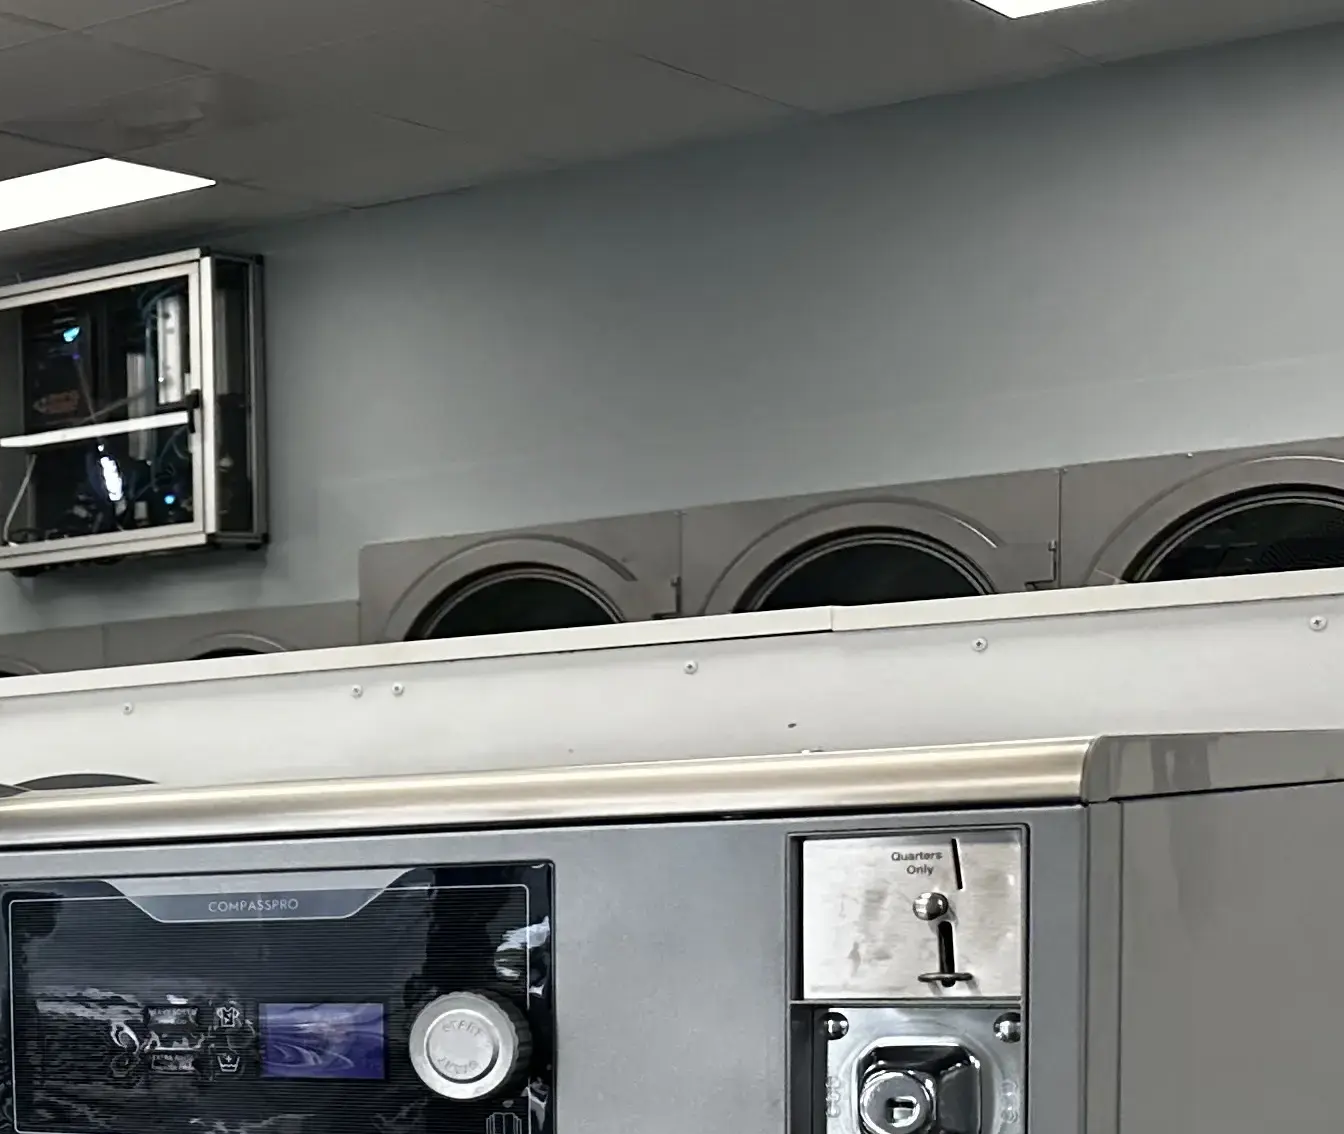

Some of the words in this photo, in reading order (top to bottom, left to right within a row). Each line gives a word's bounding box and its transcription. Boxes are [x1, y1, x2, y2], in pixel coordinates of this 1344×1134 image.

[891, 851, 943, 861] Quarters
[906, 864, 934, 876] Only
[208, 898, 299, 912] COMPASSPRO
